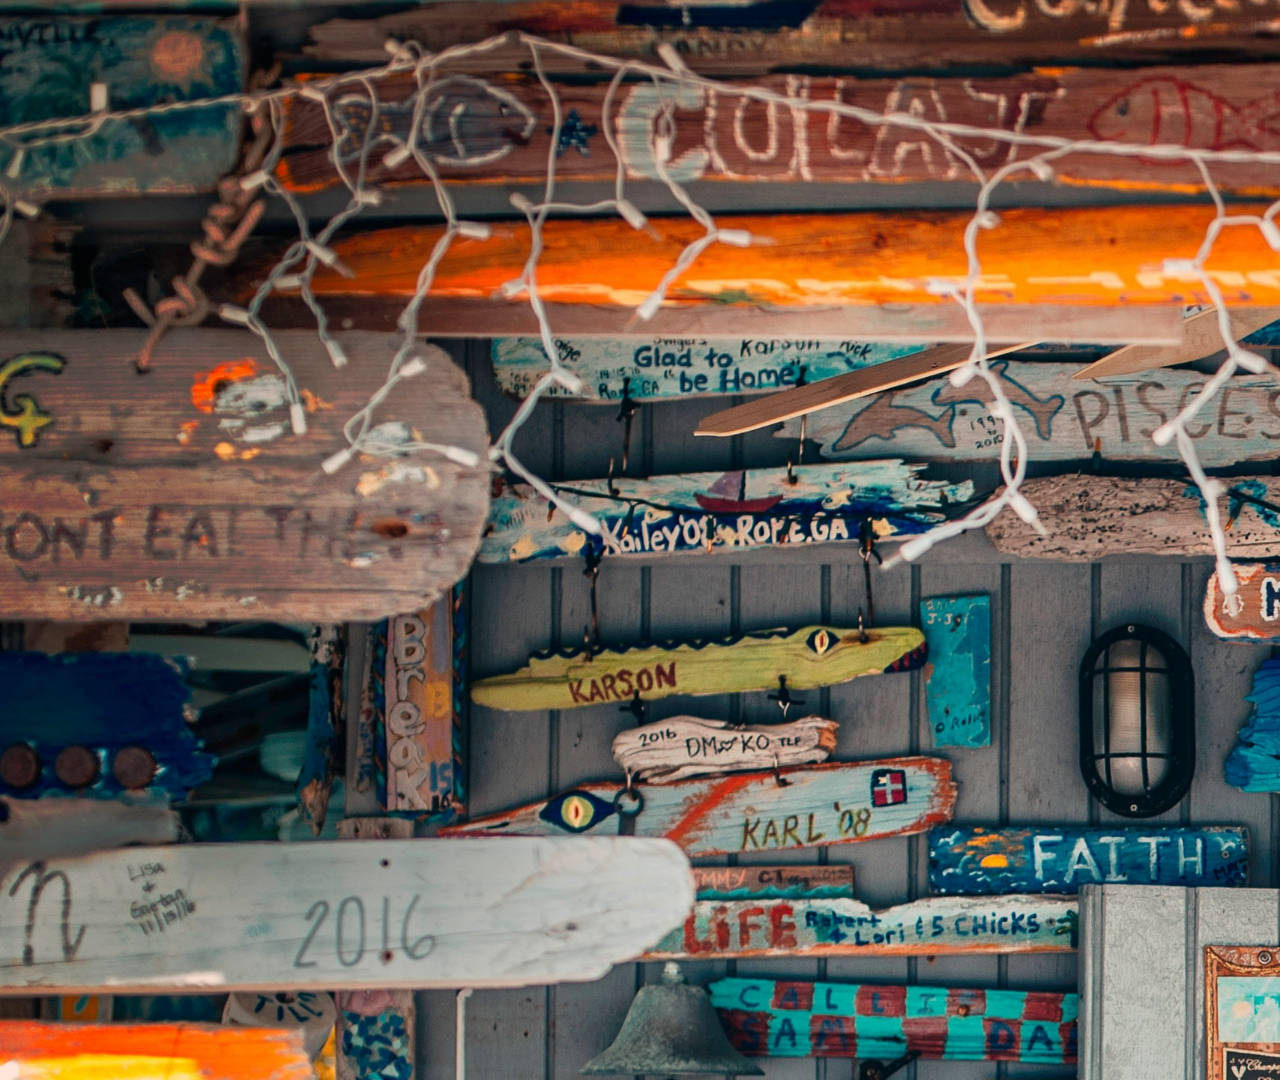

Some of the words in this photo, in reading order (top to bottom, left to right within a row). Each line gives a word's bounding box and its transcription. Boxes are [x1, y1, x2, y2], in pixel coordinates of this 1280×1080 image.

[634, 348, 693, 369] Glad
[704, 349, 733, 368] to
[568, 661, 678, 705] KARSON
[637, 726, 678, 748] 2016
[740, 815, 825, 852] KARL
[1032, 835, 1204, 884] FAITH
[293, 893, 438, 970] 2016
